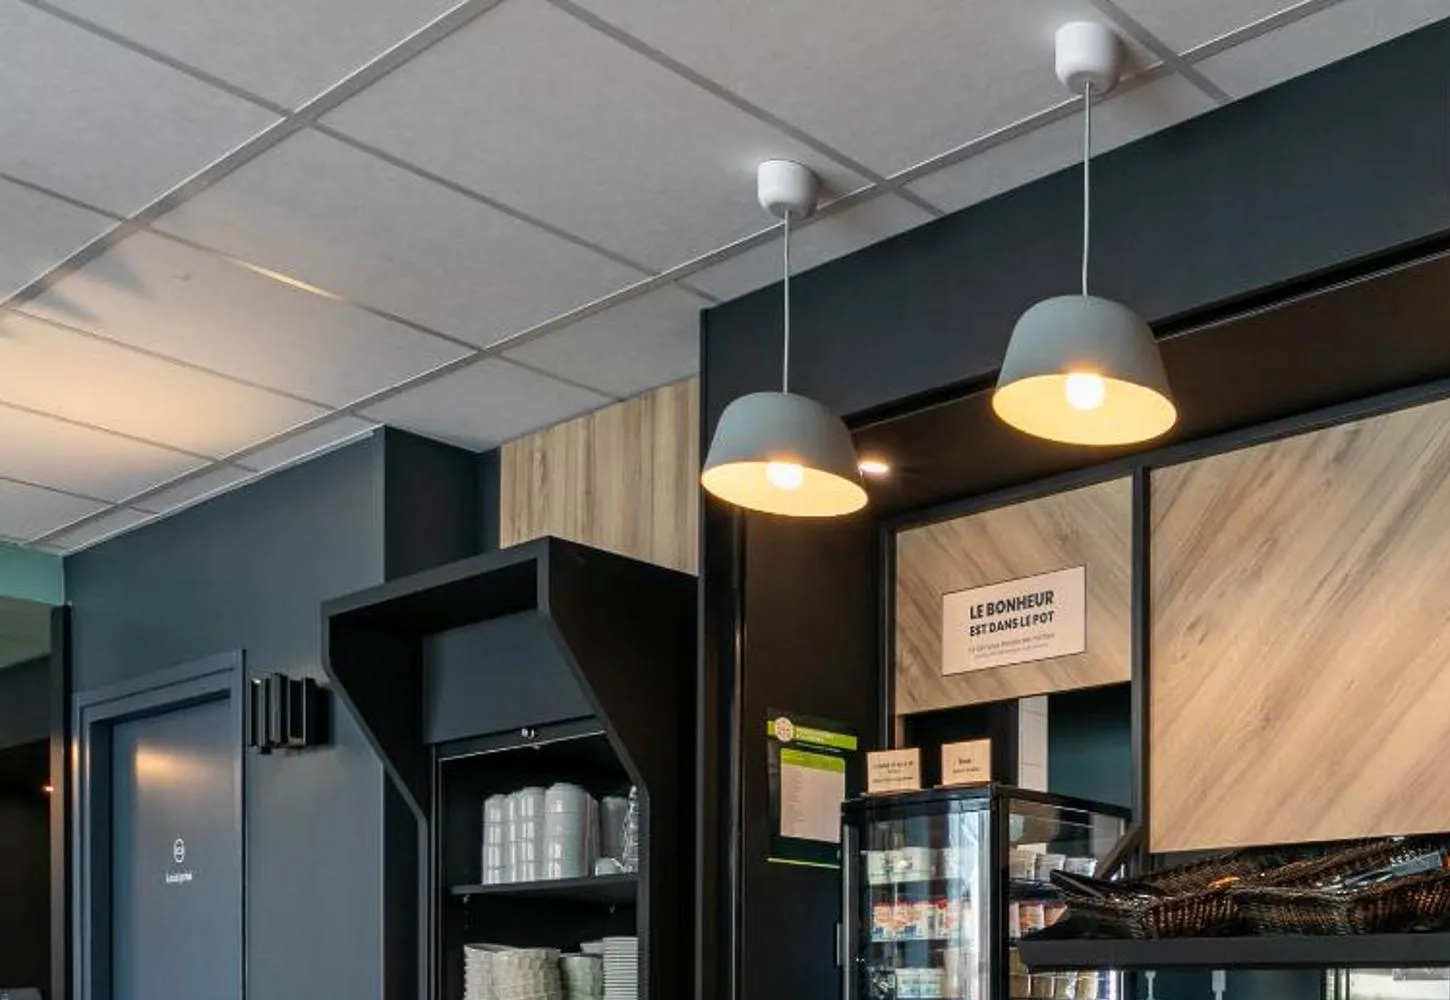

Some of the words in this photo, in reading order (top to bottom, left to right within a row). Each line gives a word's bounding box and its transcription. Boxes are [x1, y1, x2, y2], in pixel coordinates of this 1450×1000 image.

[970, 604, 984, 620] LE
[987, 591, 1054, 616] BONHEUR
[970, 625, 987, 637] EST
[989, 618, 1018, 632] DANS
[1020, 615, 1030, 627] LE
[1033, 611, 1054, 624] POT
